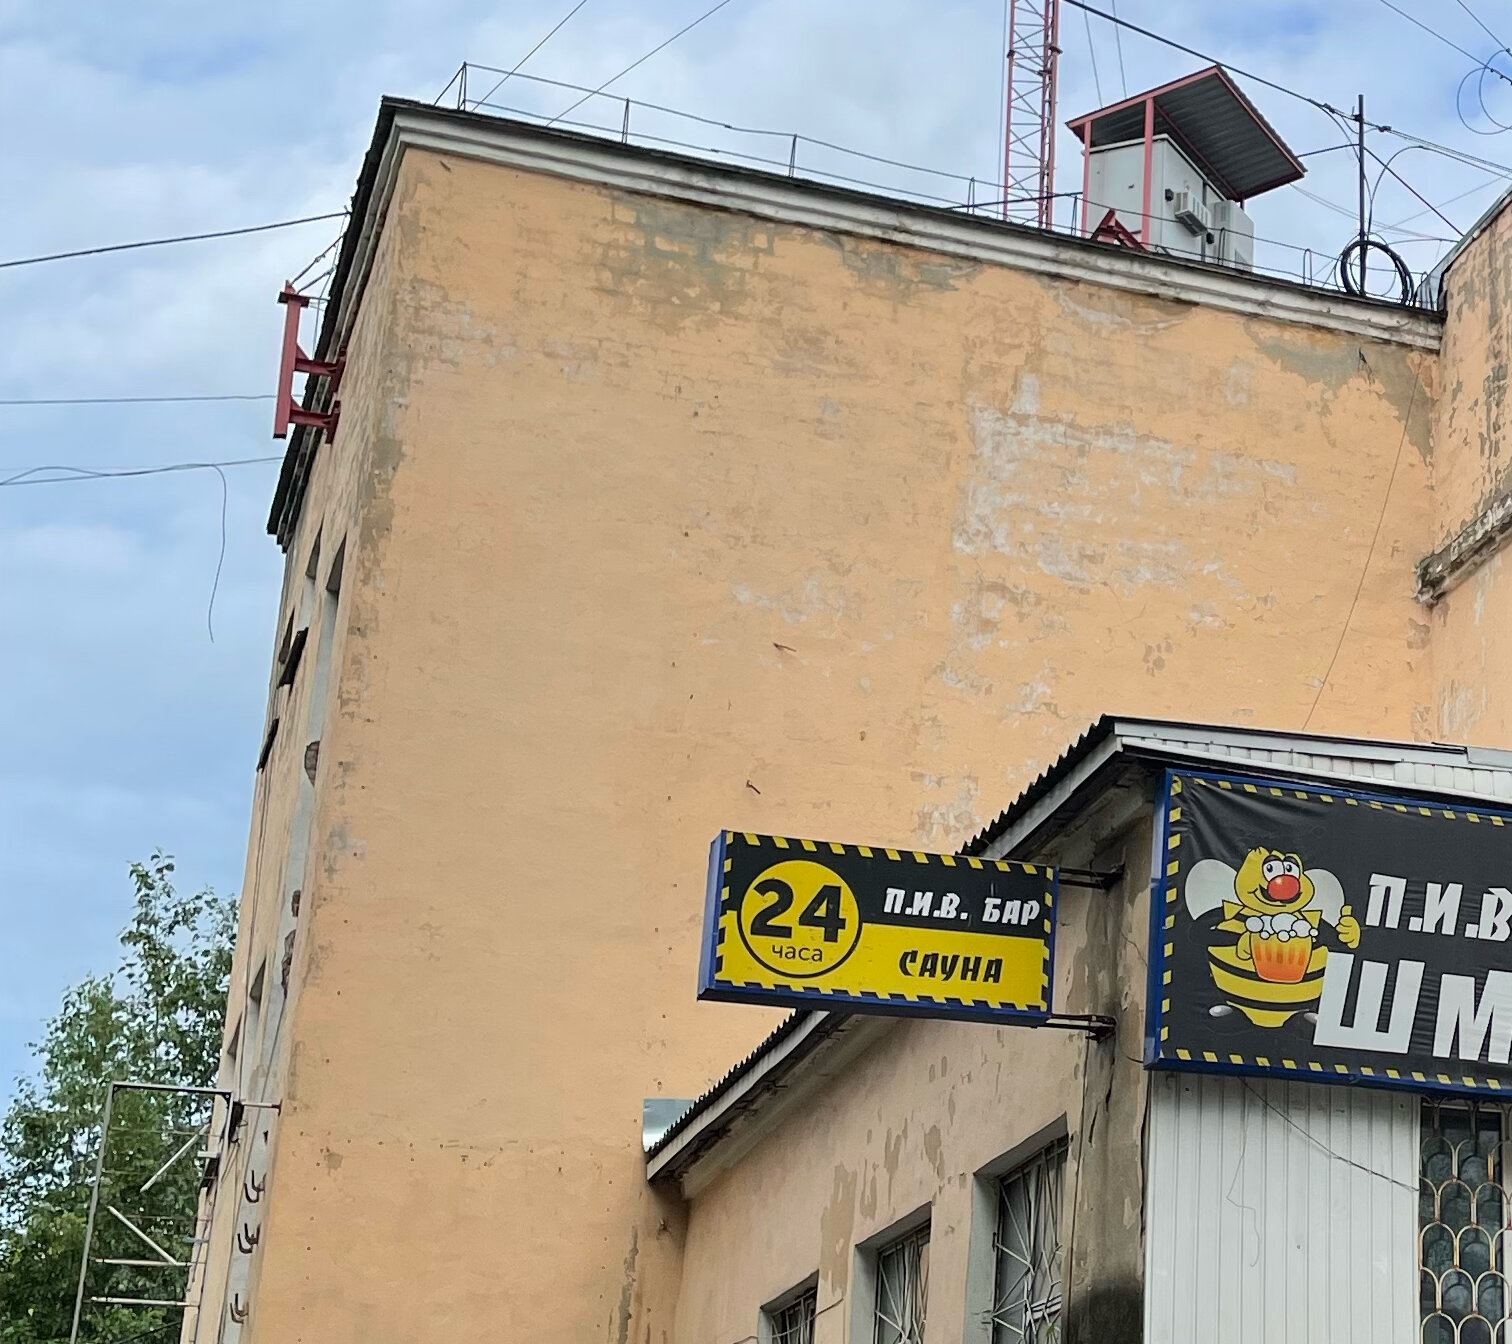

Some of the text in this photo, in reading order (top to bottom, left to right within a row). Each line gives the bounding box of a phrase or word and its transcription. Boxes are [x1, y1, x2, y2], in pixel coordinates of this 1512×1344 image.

[750, 878, 846, 943] 24
[884, 887, 1041, 926] П.И.В. БАР
[771, 943, 824, 963] часа
[900, 950, 1003, 983] САУНА
